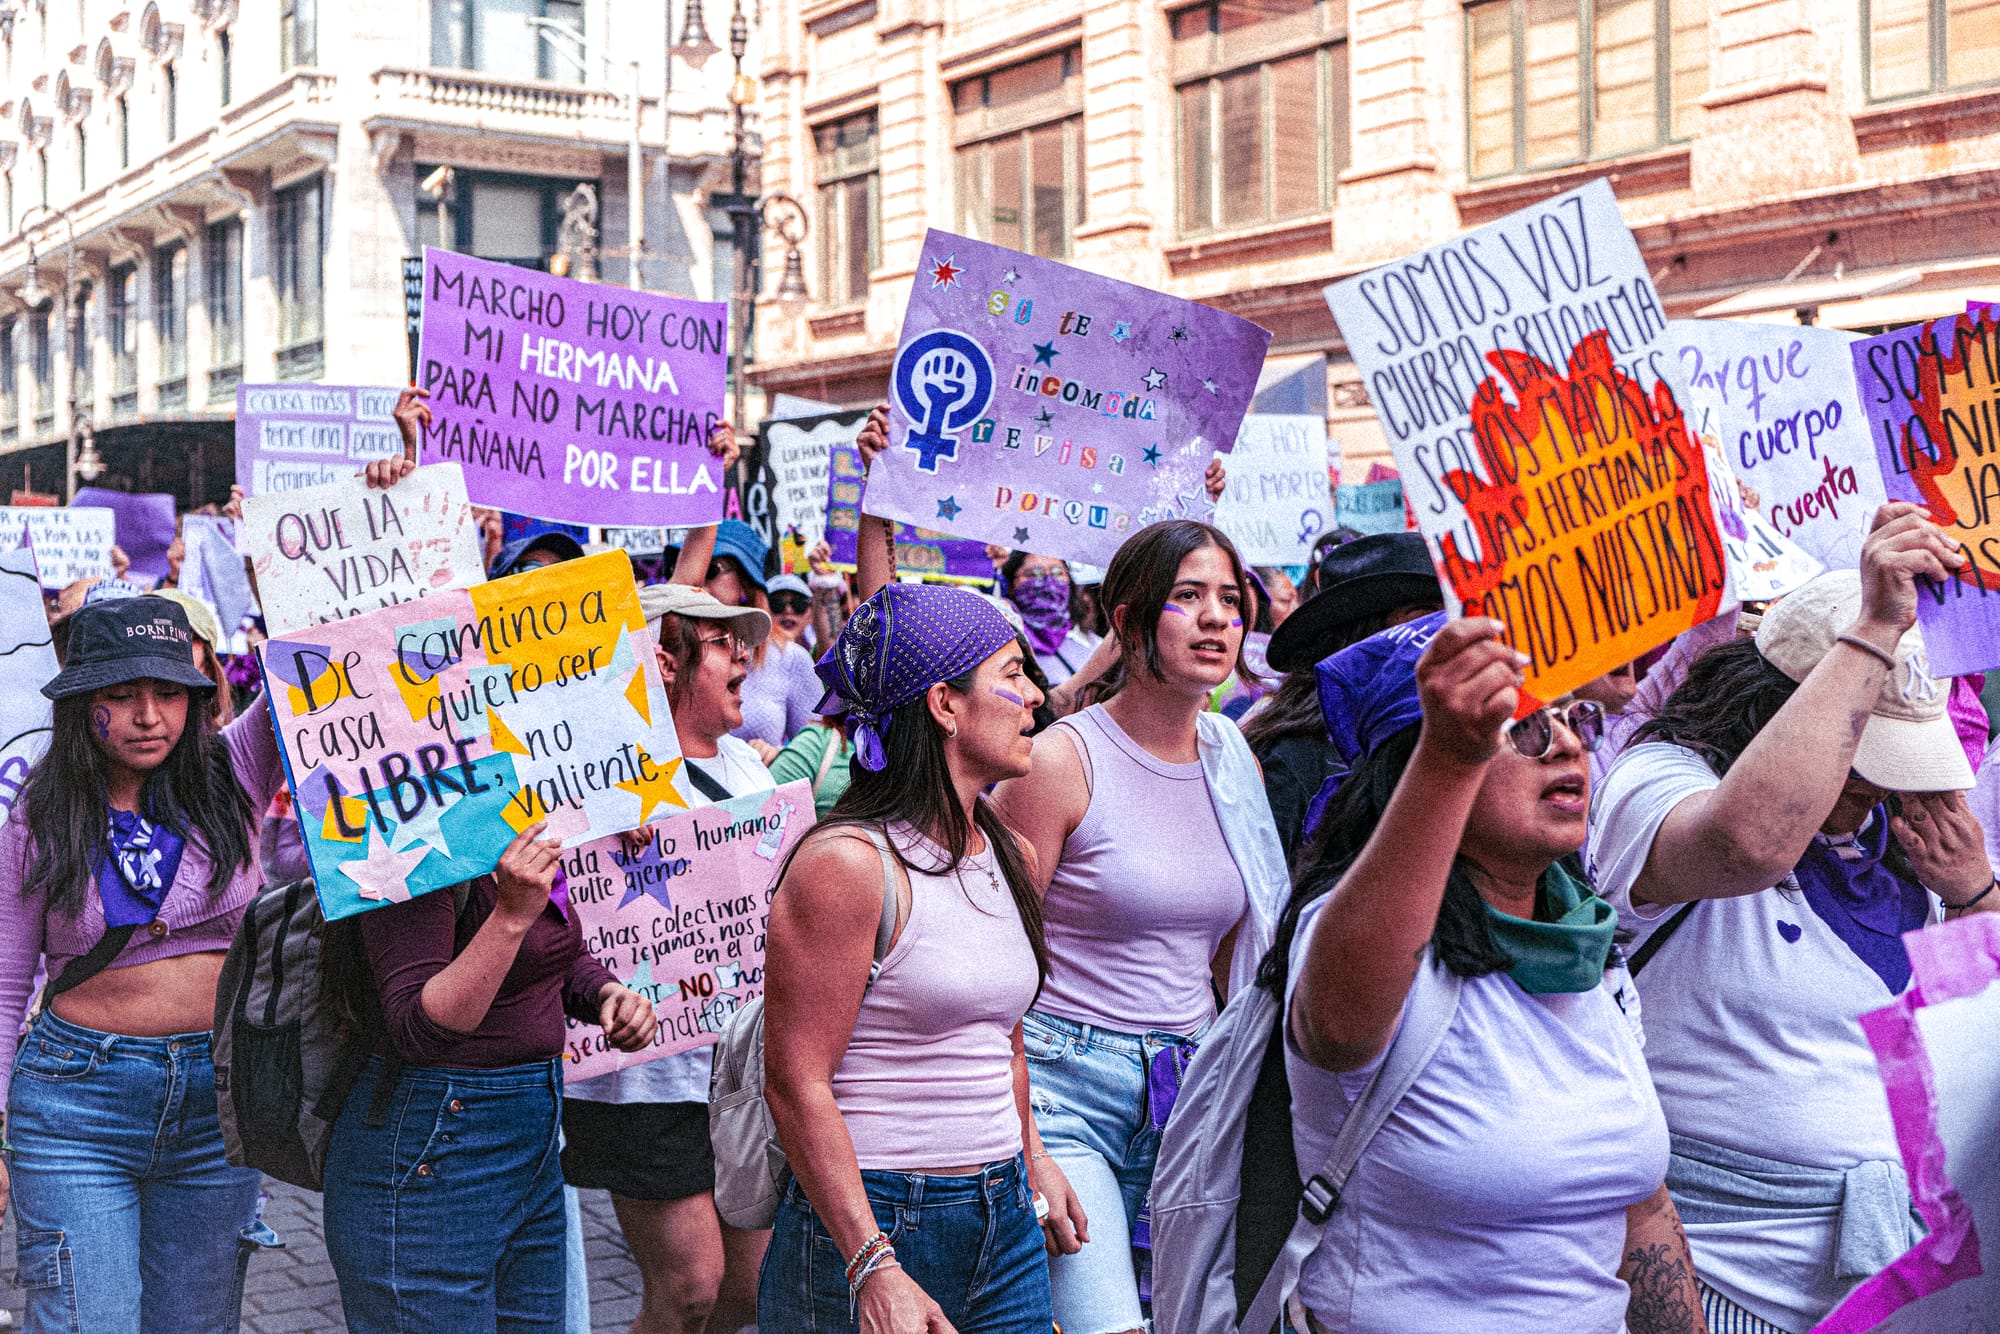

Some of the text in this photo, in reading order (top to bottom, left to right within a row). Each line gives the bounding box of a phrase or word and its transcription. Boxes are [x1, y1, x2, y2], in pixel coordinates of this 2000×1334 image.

[432, 263, 566, 328] MARCHO
[586, 301, 651, 343] HOY
[660, 312, 723, 355] CON
[1359, 195, 1612, 357] SOMOS VOZ
[425, 360, 498, 414] PARA
[512, 380, 560, 424] NO
[464, 318, 679, 396] MI HERMANA
[1867, 320, 2000, 403] SOY M
[420, 416, 719, 496] MAÑANA POR ELLA
[1414, 350, 1679, 514] SOMOS MADRES
[1739, 399, 1843, 469] cuerpo
[1883, 413, 1937, 474] LA
[1535, 427, 1691, 540] HERMANAS
[1771, 455, 1859, 539] cuenta
[276, 493, 405, 565] QUE LA
[1574, 485, 1726, 645] NUESTRAS
[323, 547, 415, 601] VIDA
[126, 624, 189, 643] BORN PINK
[293, 589, 608, 716] De camino a
[295, 645, 604, 770] casa quiero ser
[324, 719, 573, 839] LIBRE, no
[508, 742, 671, 820] valiente.
[614, 839, 642, 868] de
[655, 828, 676, 859] lo
[692, 812, 782, 852] humano
[583, 925, 641, 955] chas
[652, 894, 757, 939] colectivas
[694, 947, 720, 965] en
[727, 938, 742, 959] el
[719, 917, 755, 942] nos
[678, 972, 714, 1002] NO
[732, 963, 766, 988] no
